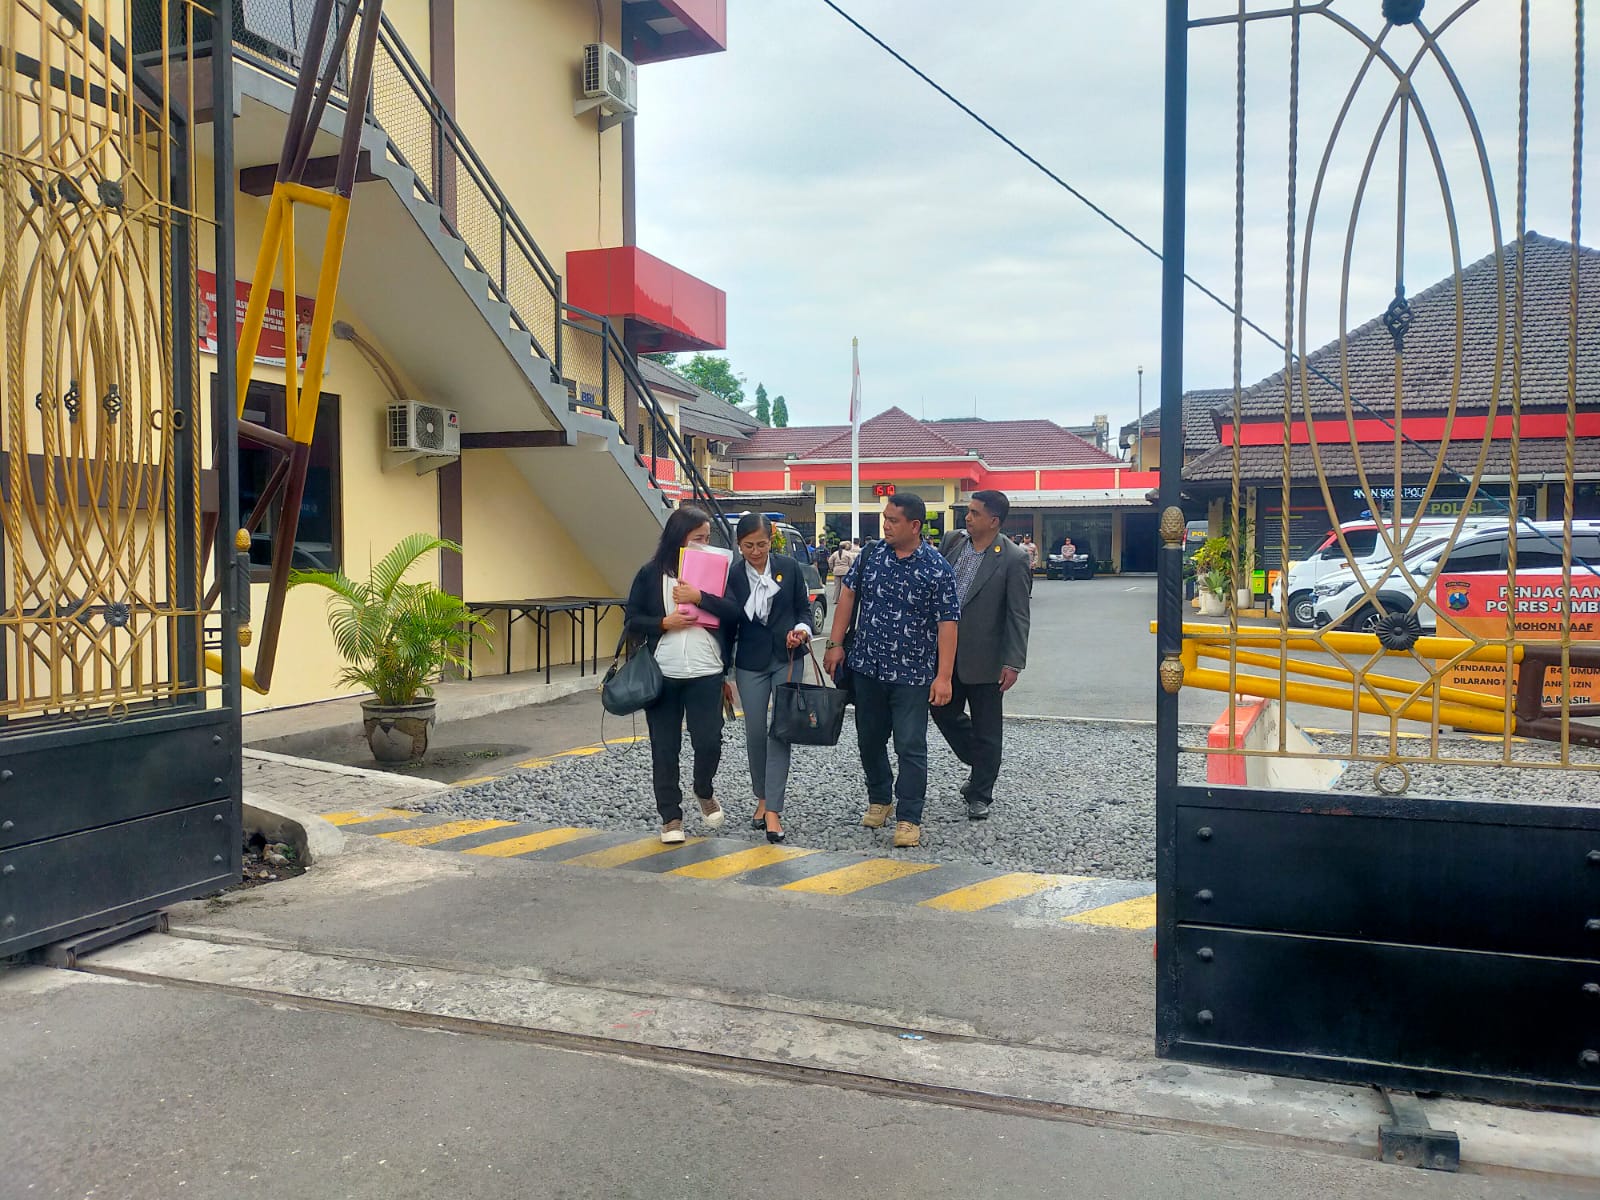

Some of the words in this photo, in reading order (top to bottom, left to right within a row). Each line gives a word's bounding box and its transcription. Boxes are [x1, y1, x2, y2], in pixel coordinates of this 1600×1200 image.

[1431, 502, 1483, 515] POLSI
[1486, 600, 1549, 612] PORES
[1552, 601, 1600, 613] JMB
[1559, 623, 1593, 632] AAF
[1454, 664, 1506, 673] KENDARAA
[1453, 677, 1500, 686] DILARANG
